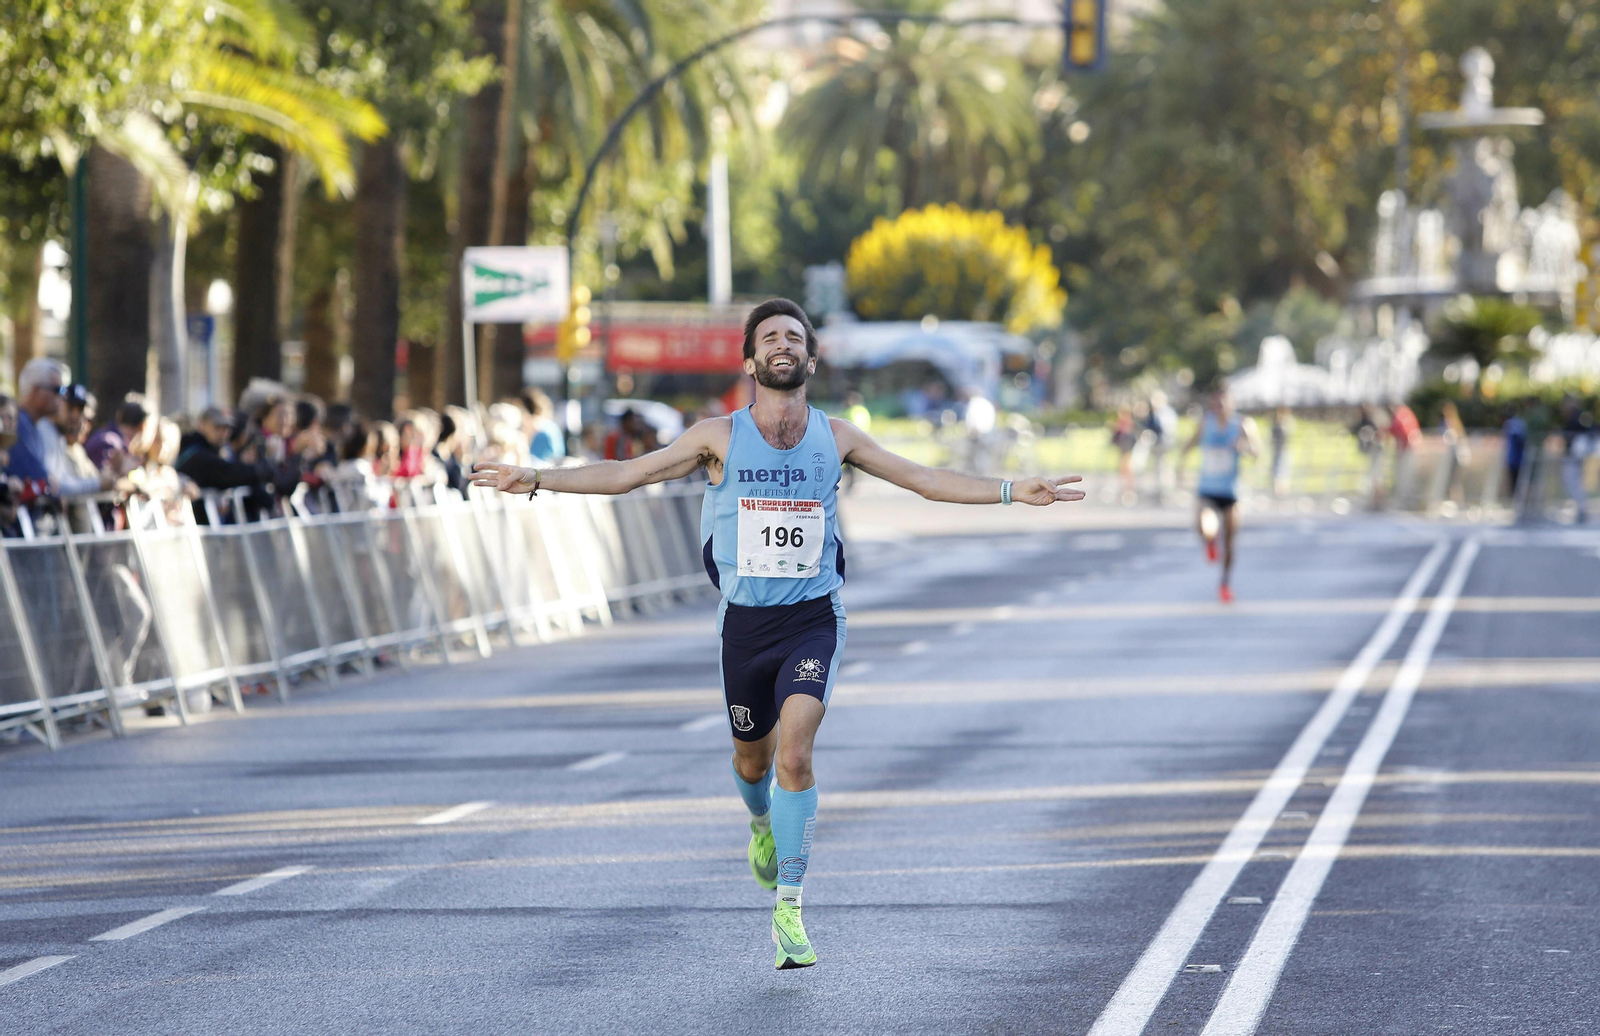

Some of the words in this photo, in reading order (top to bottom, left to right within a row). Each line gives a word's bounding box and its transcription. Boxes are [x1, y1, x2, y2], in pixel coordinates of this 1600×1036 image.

[738, 464, 807, 487] nerja
[748, 488, 798, 497] ATLETISMO
[741, 499, 756, 511] 41
[761, 526, 804, 548] 196
